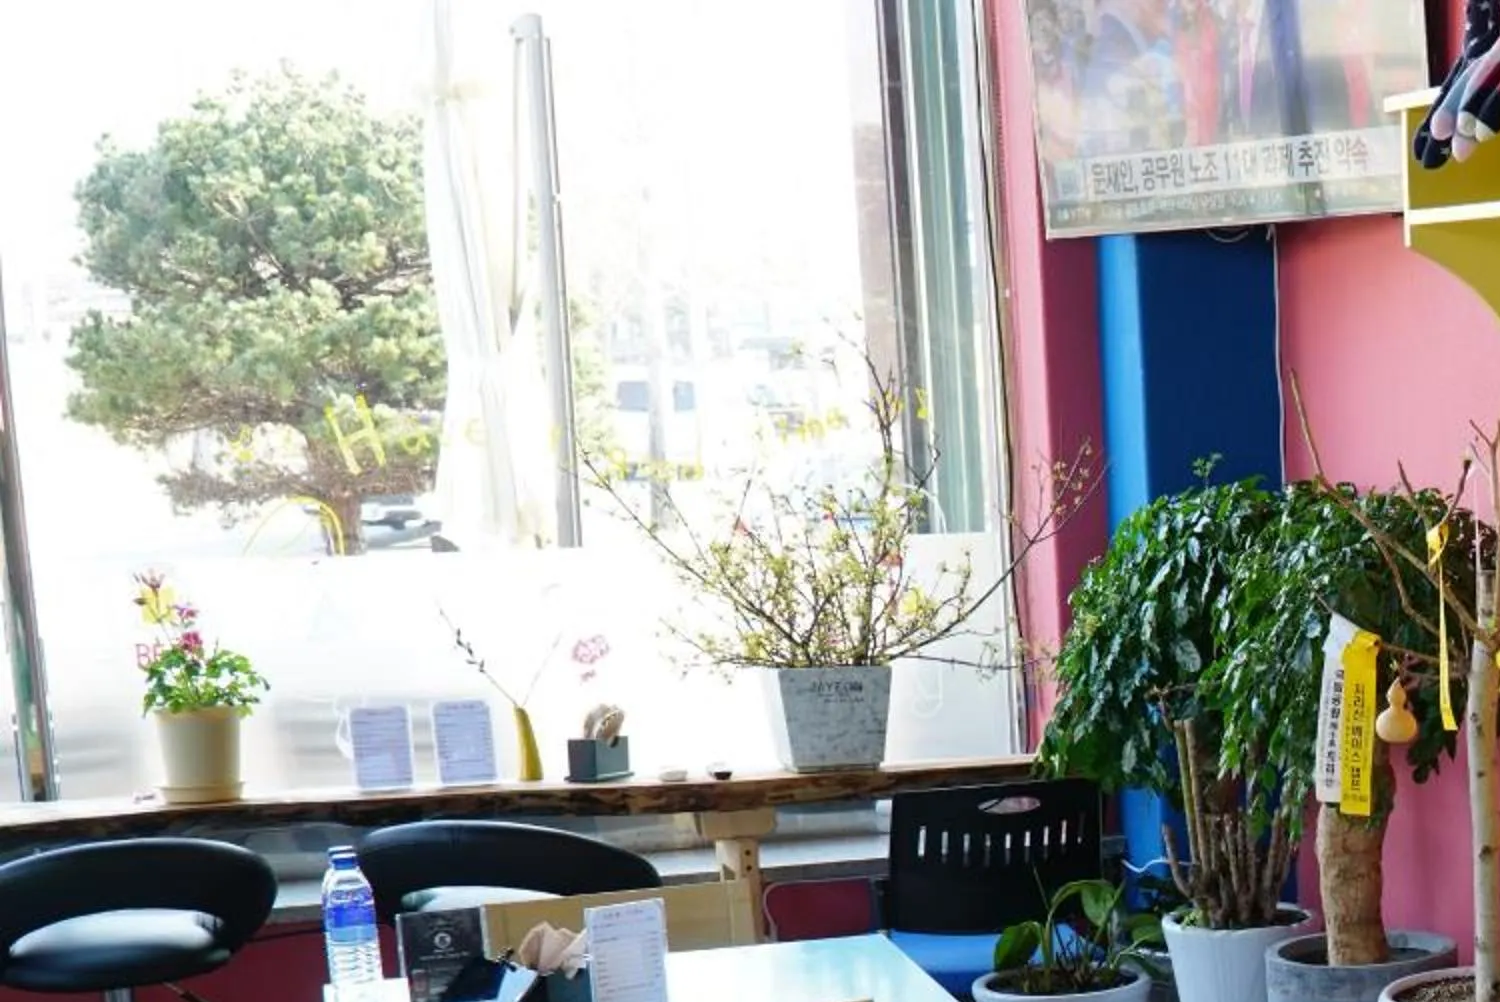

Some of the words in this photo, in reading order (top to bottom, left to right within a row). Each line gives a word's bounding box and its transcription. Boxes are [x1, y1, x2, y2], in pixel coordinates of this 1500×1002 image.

[1141, 152, 1185, 188] 공무원
[1188, 150, 1220, 182] 노조
[1297, 139, 1331, 176] 추진
[1332, 136, 1370, 171] 약속
